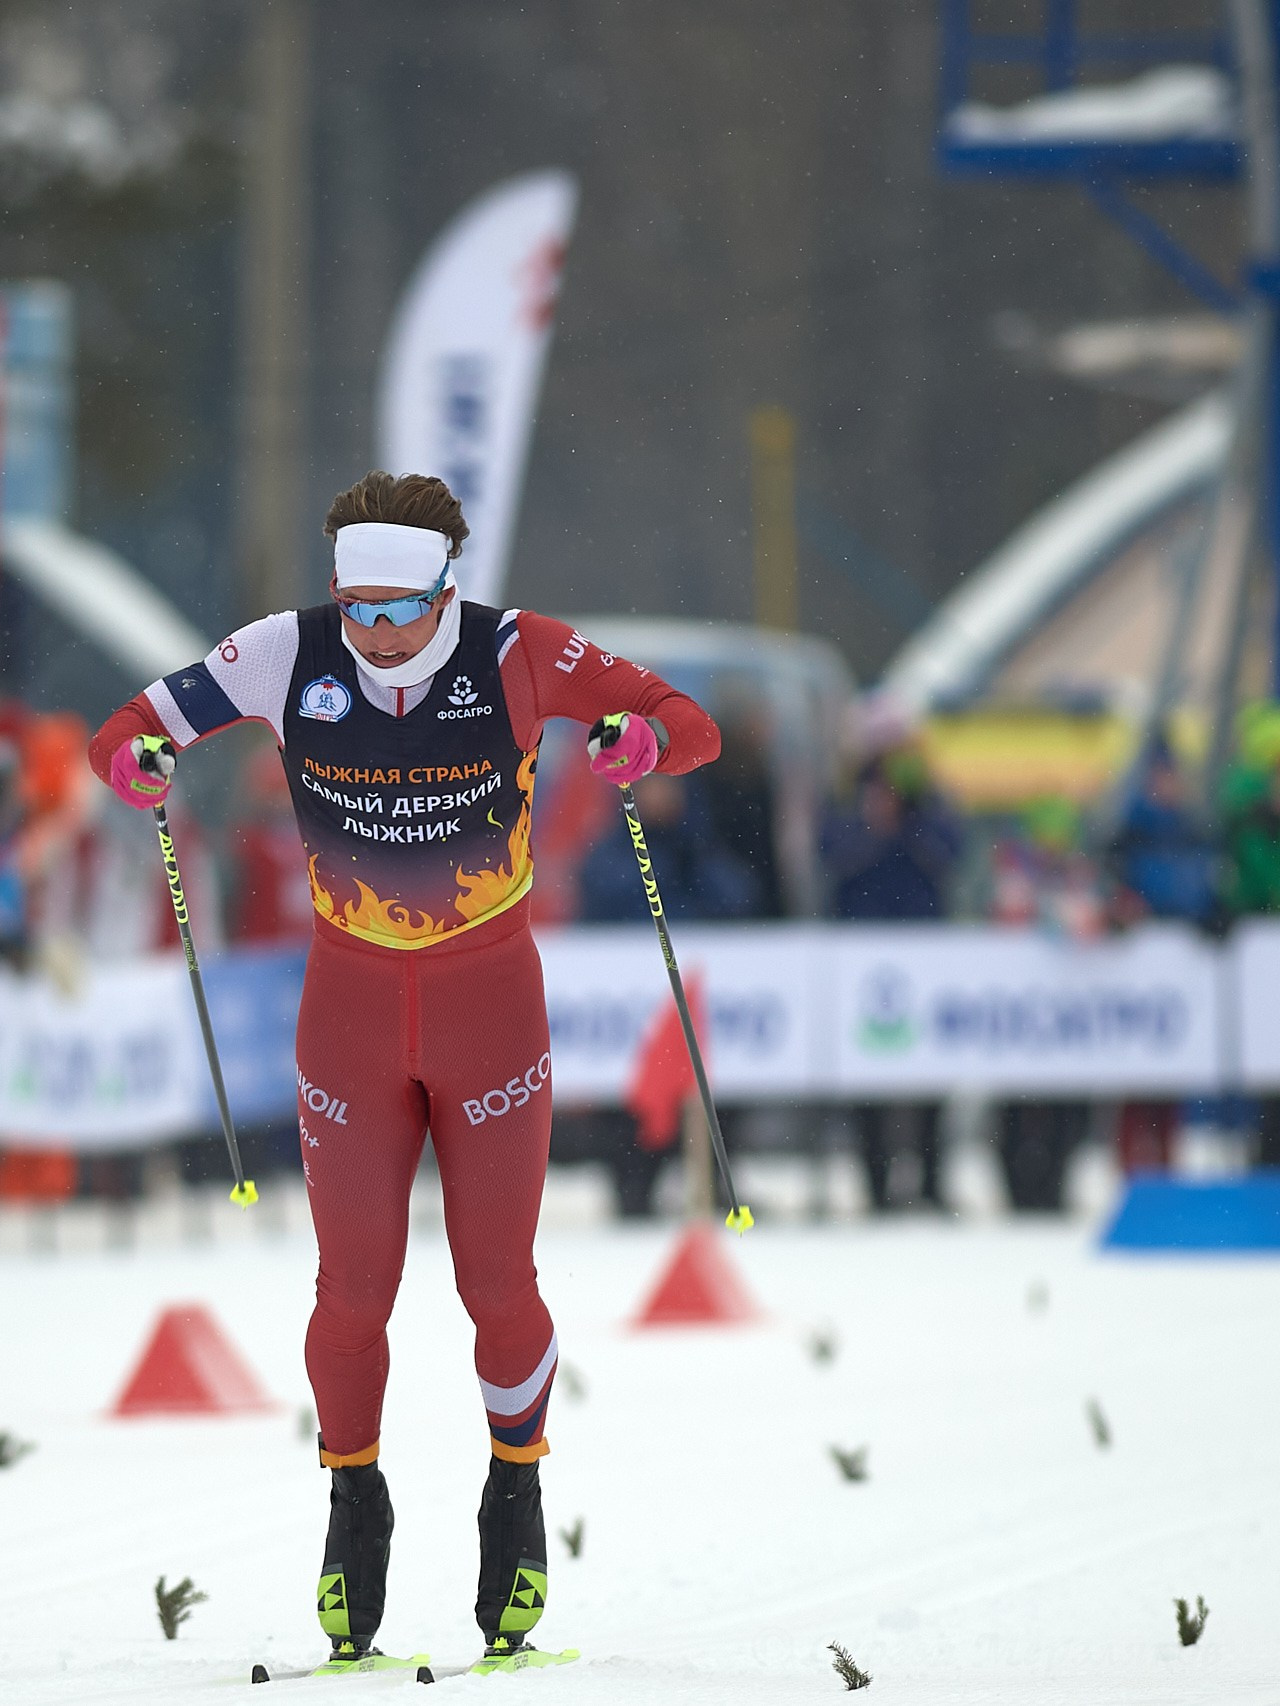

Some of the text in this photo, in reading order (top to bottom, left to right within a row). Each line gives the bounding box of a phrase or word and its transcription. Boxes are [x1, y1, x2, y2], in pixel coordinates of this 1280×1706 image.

[436, 704, 494, 721] ФОСАГРО
[304, 757, 493, 785] ЛЫЖНАЯ СТРАНА
[301, 771, 503, 818] САМЫЙ ДЕРЗКИЙ
[342, 816, 462, 844] ЛЫЖНИК
[462, 1051, 551, 1126] BOSCO
